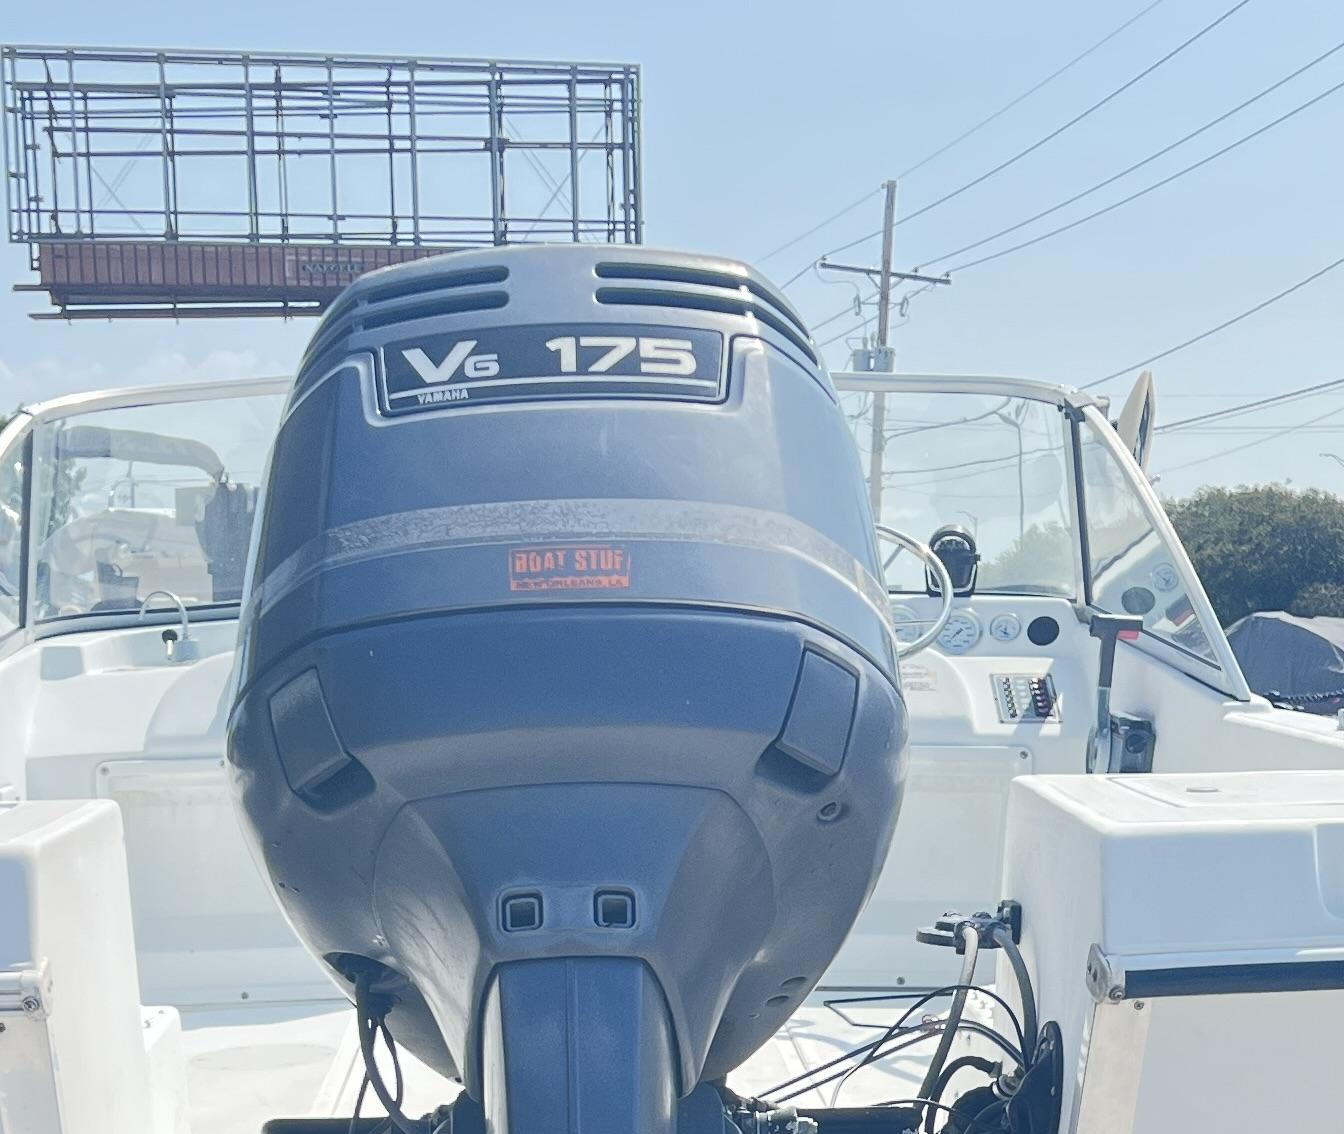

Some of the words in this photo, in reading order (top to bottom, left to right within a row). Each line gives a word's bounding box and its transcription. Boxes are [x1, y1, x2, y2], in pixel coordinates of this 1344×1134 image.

[401, 340, 500, 384] V6
[545, 336, 697, 375] 175
[417, 388, 469, 405] YAMAHA
[515, 550, 565, 572] BOAT
